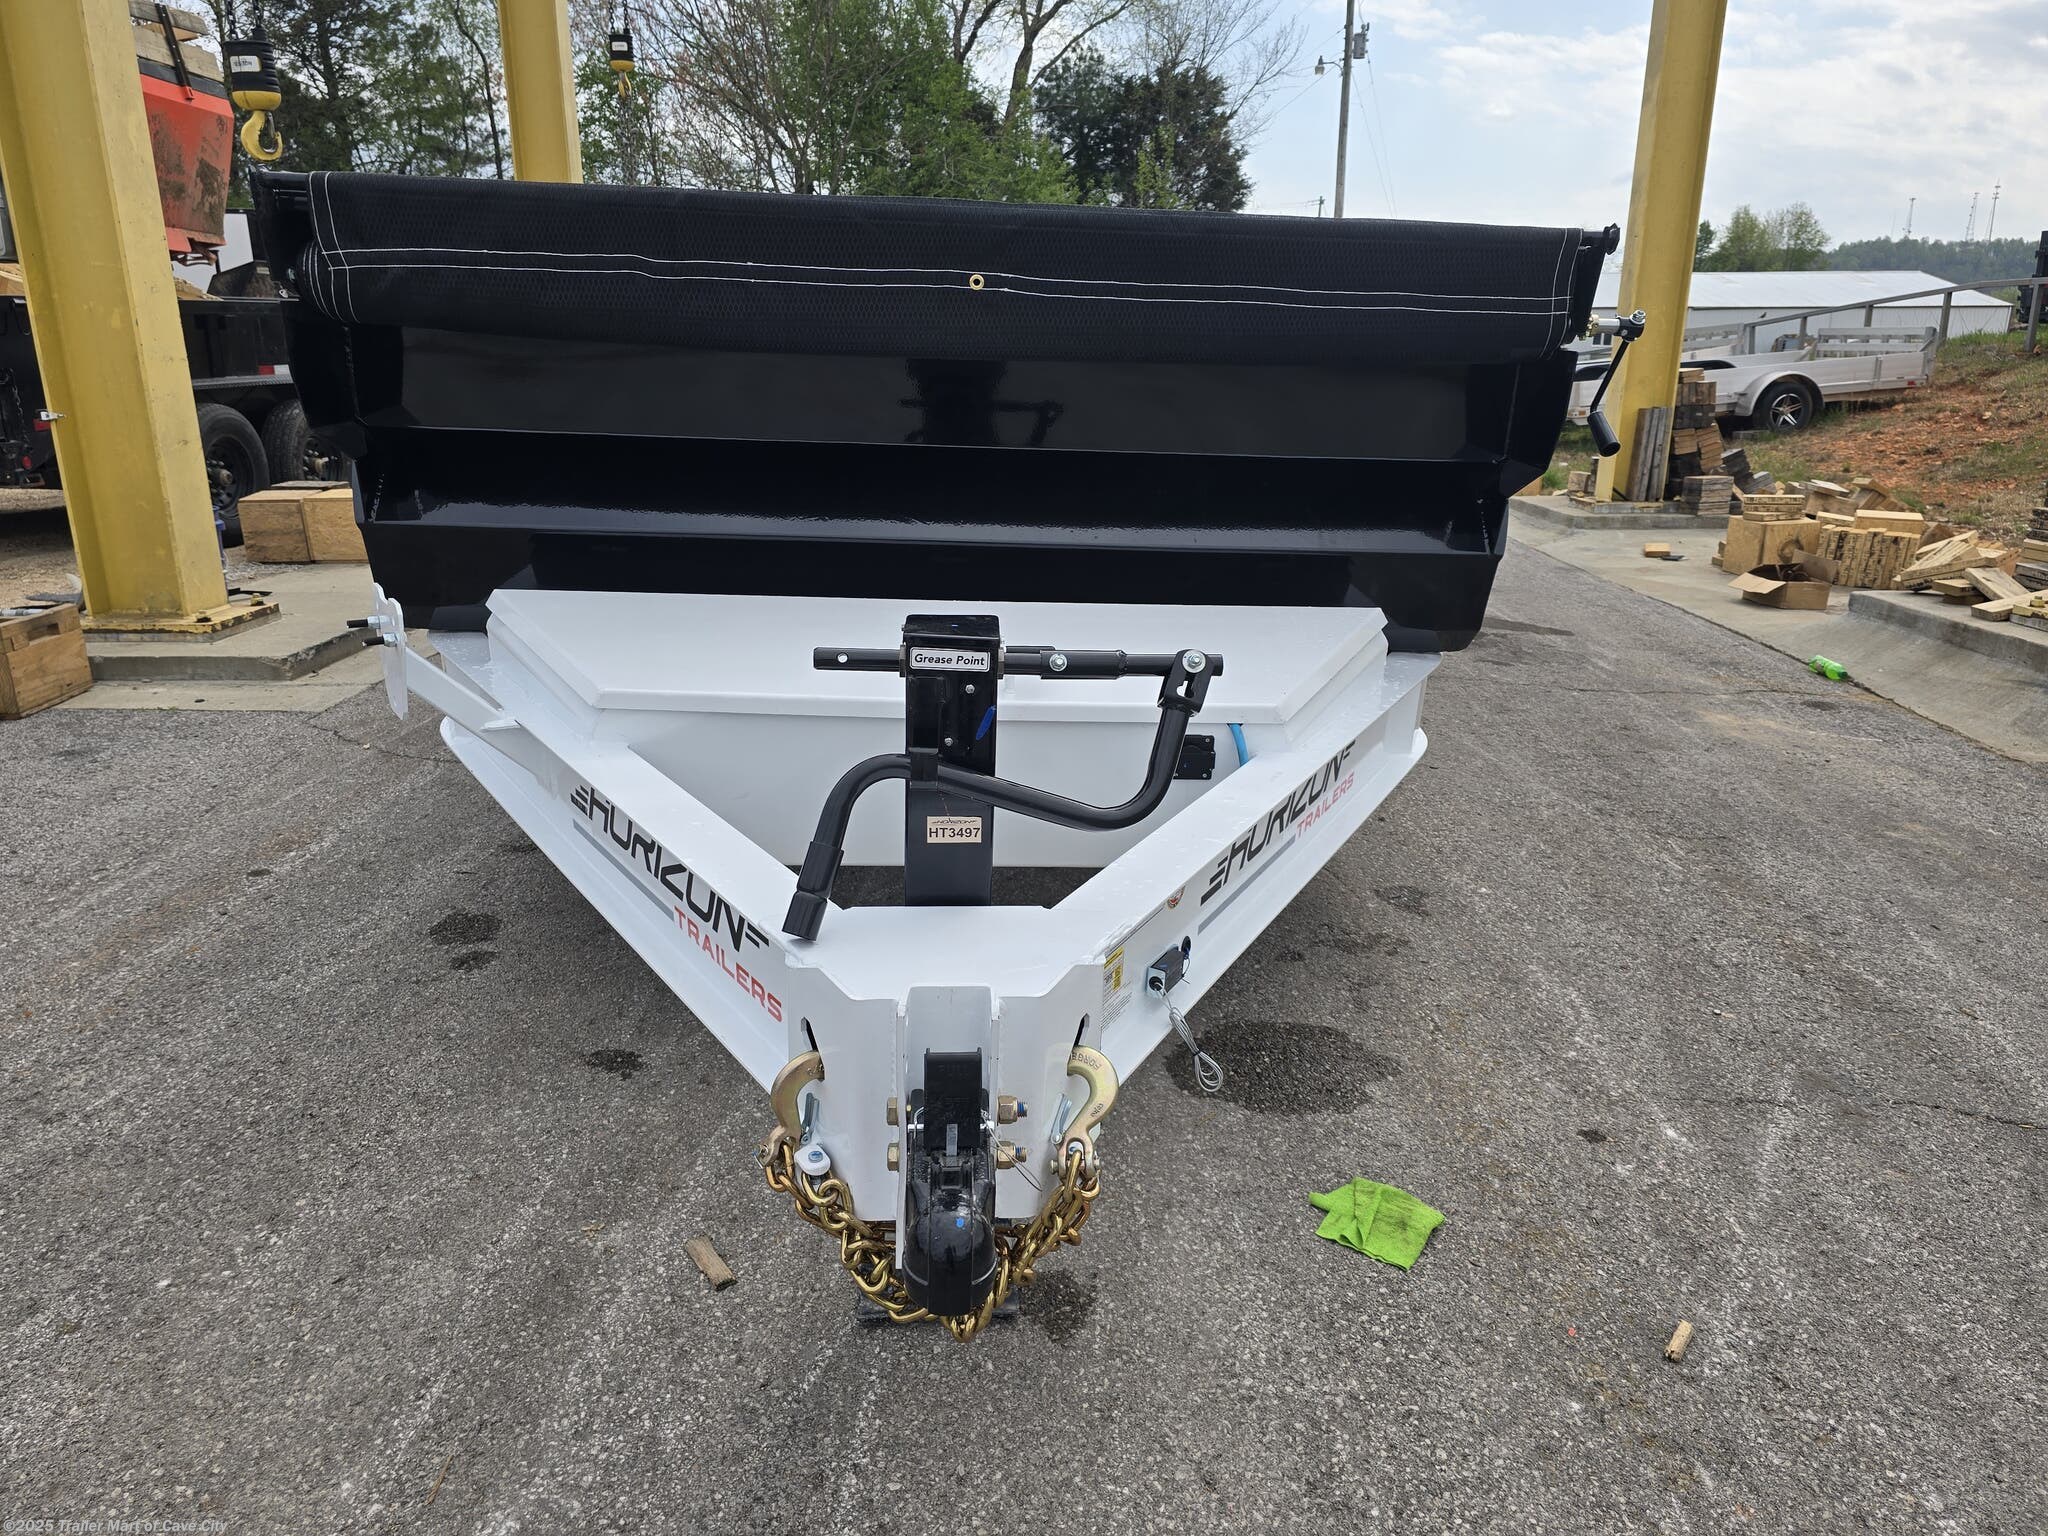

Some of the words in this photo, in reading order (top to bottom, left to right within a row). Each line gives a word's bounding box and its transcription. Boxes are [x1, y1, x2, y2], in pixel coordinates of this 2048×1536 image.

[914, 653, 953, 665] Grease
[956, 655, 985, 666] Point
[1297, 771, 1354, 838] TRAILERS
[928, 827, 981, 838] HT3497
[674, 905, 783, 1022] TRAILERS
